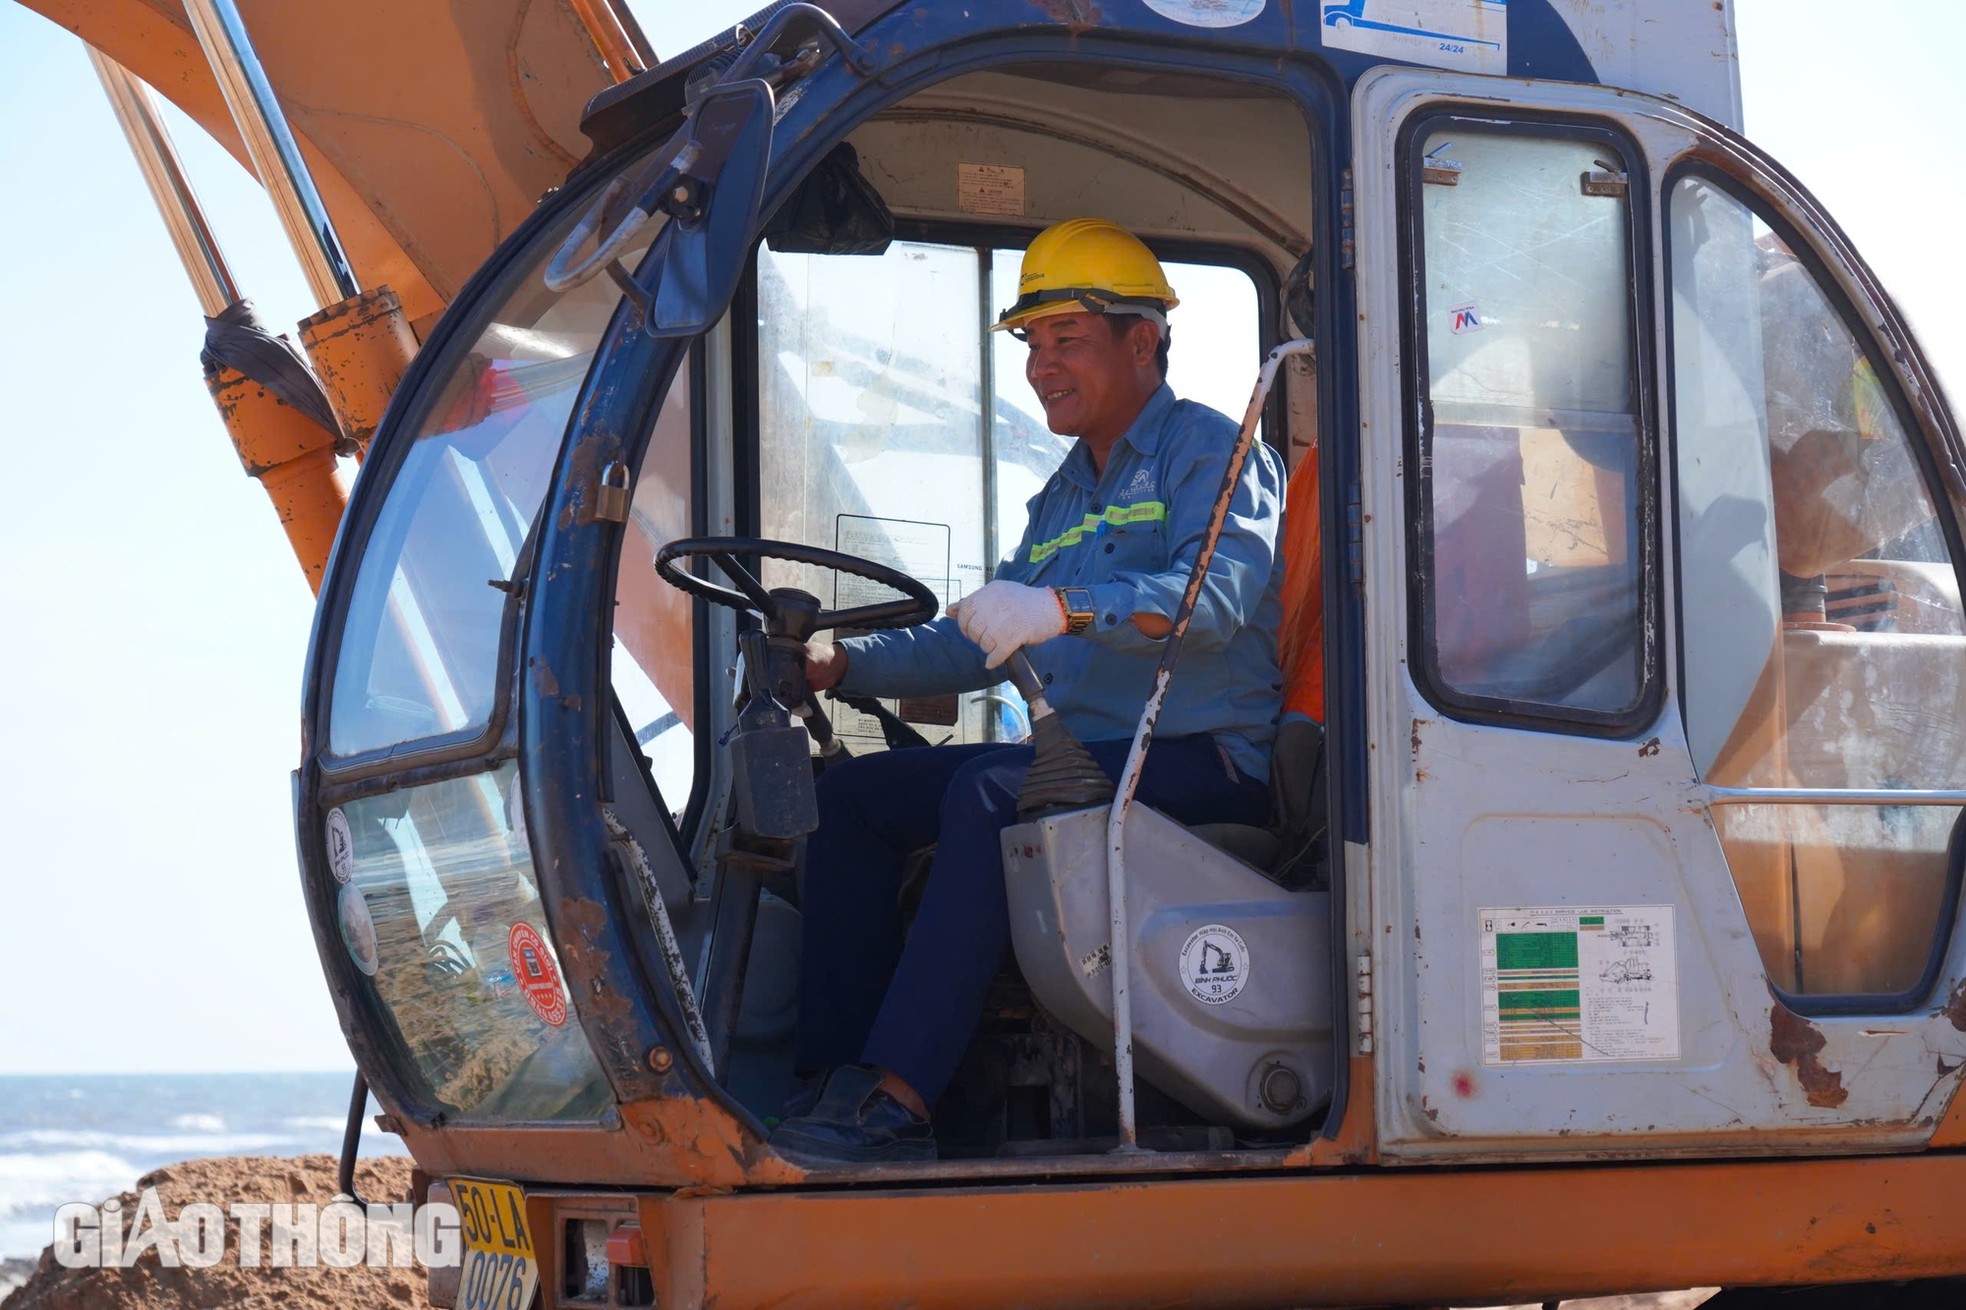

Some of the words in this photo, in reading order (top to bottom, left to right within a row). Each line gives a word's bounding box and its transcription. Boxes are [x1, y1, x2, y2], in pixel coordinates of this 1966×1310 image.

[1440, 43, 1464, 53] 24/24
[957, 563, 983, 571] SAMSUNG
[1191, 987, 1238, 1003] EXCAVATOR
[1211, 984, 1222, 993] 93
[455, 1183, 530, 1250] 50-LA
[465, 1250, 527, 1310] 0076
